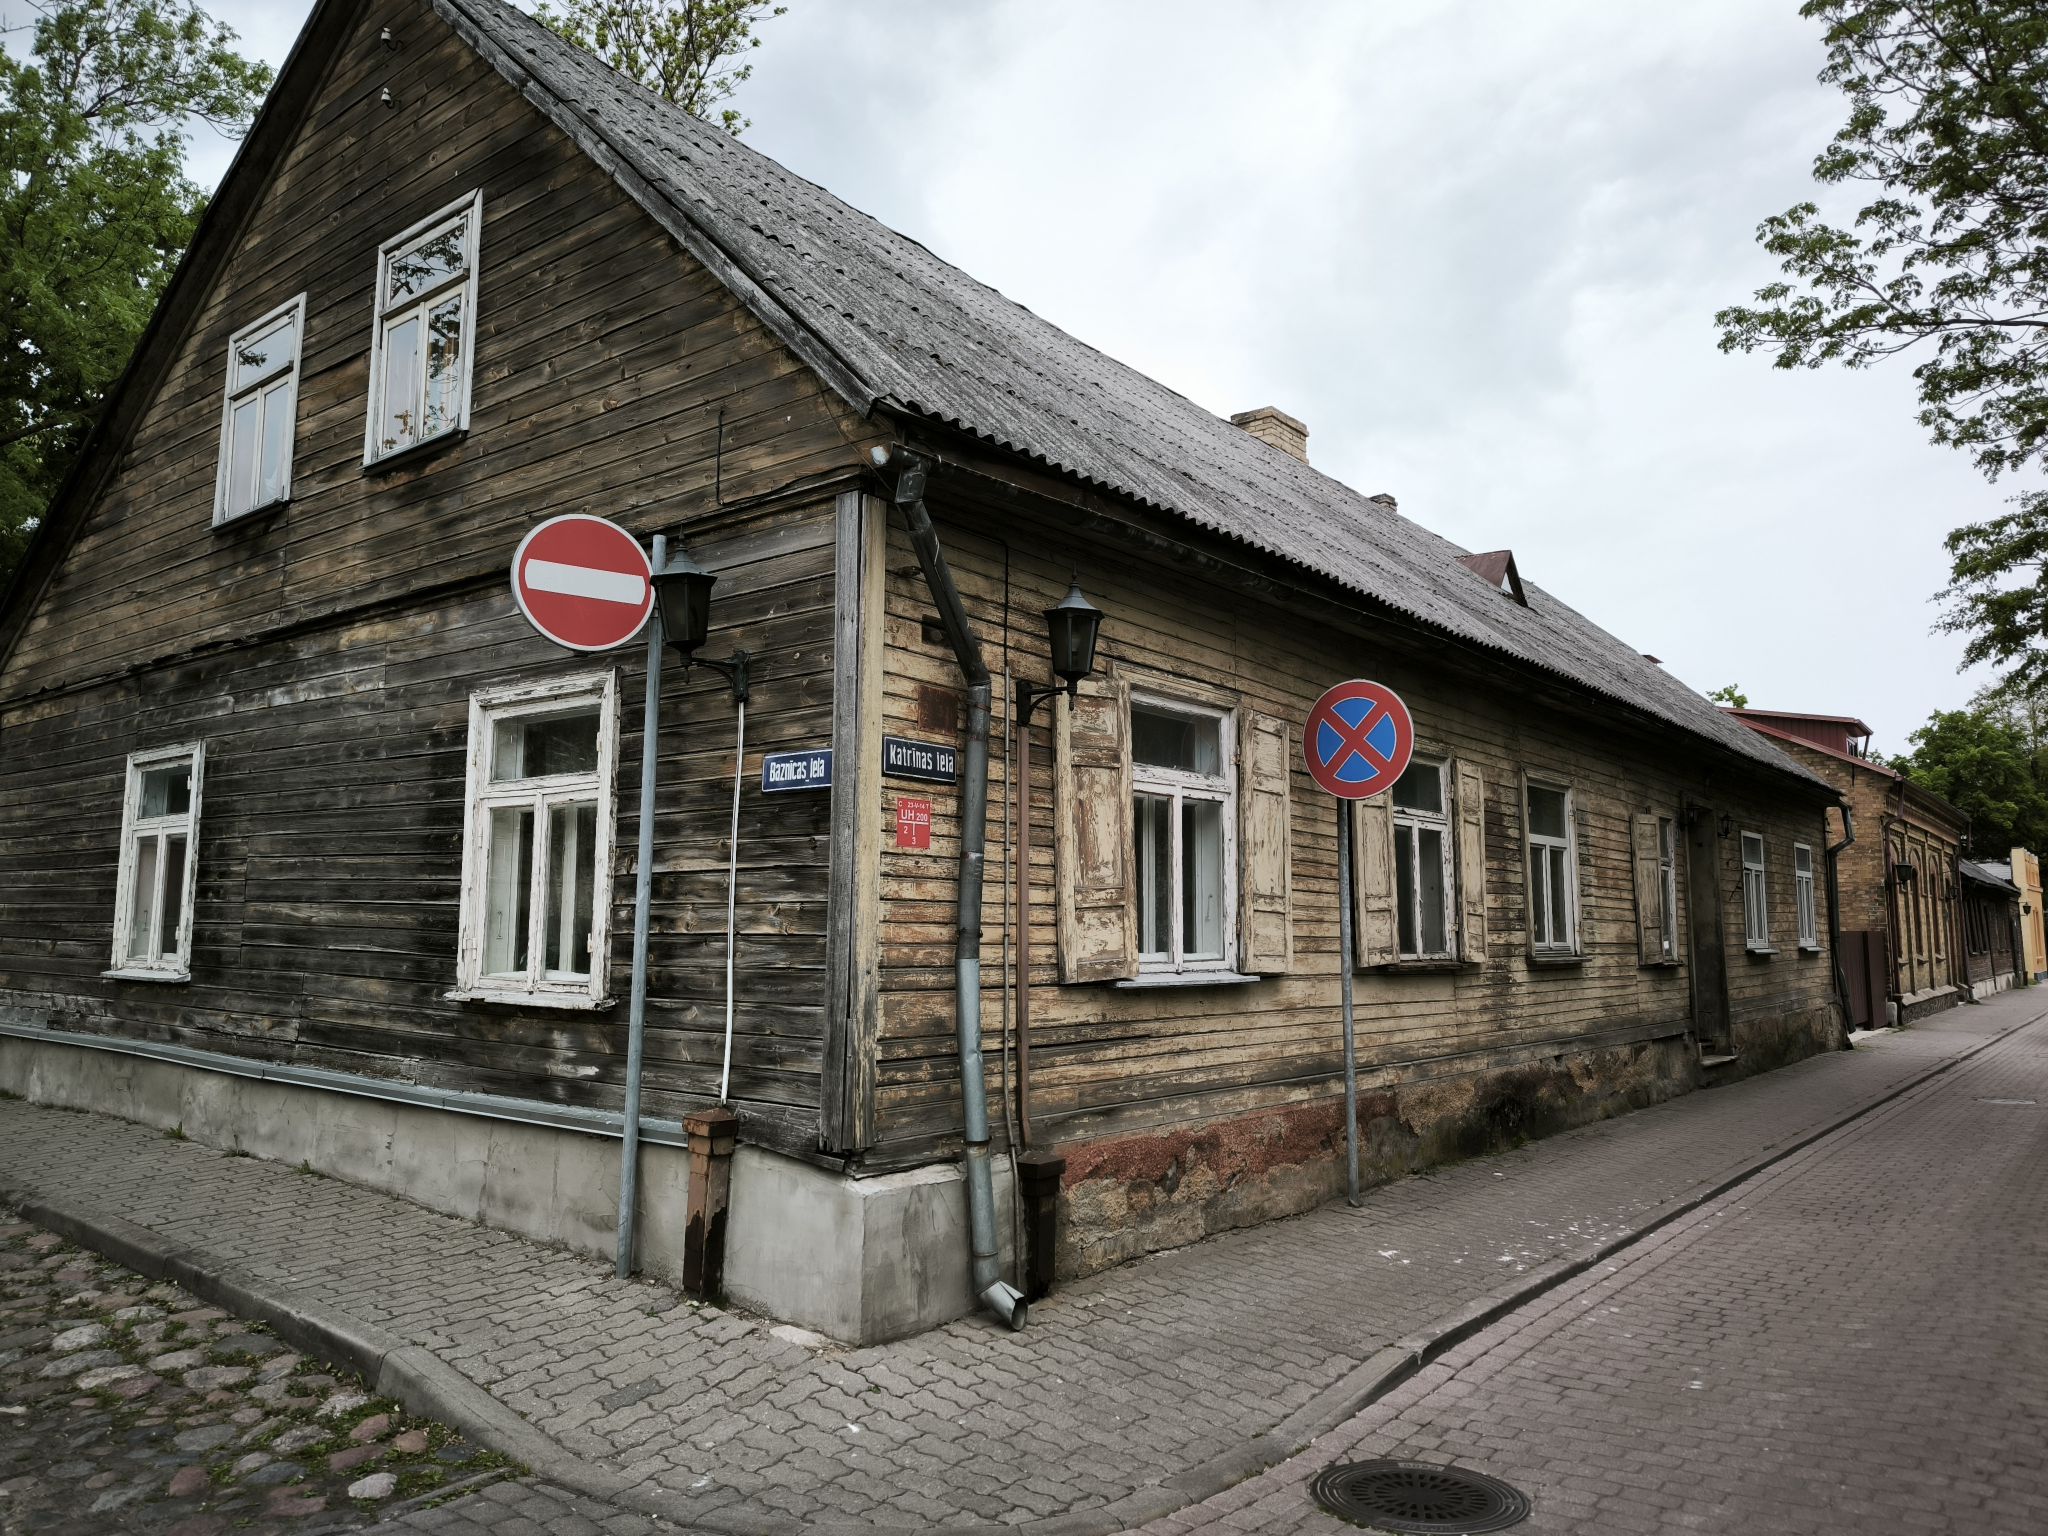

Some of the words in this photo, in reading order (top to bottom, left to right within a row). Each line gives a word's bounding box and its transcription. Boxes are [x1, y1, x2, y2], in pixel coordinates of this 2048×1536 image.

[769, 760, 807, 782] Baznīcas
[809, 757, 825, 778] iela
[890, 744, 933, 770] Katrīnas
[937, 751, 954, 773] iela
[901, 809, 915, 820] UH
[916, 812, 928, 822] 200
